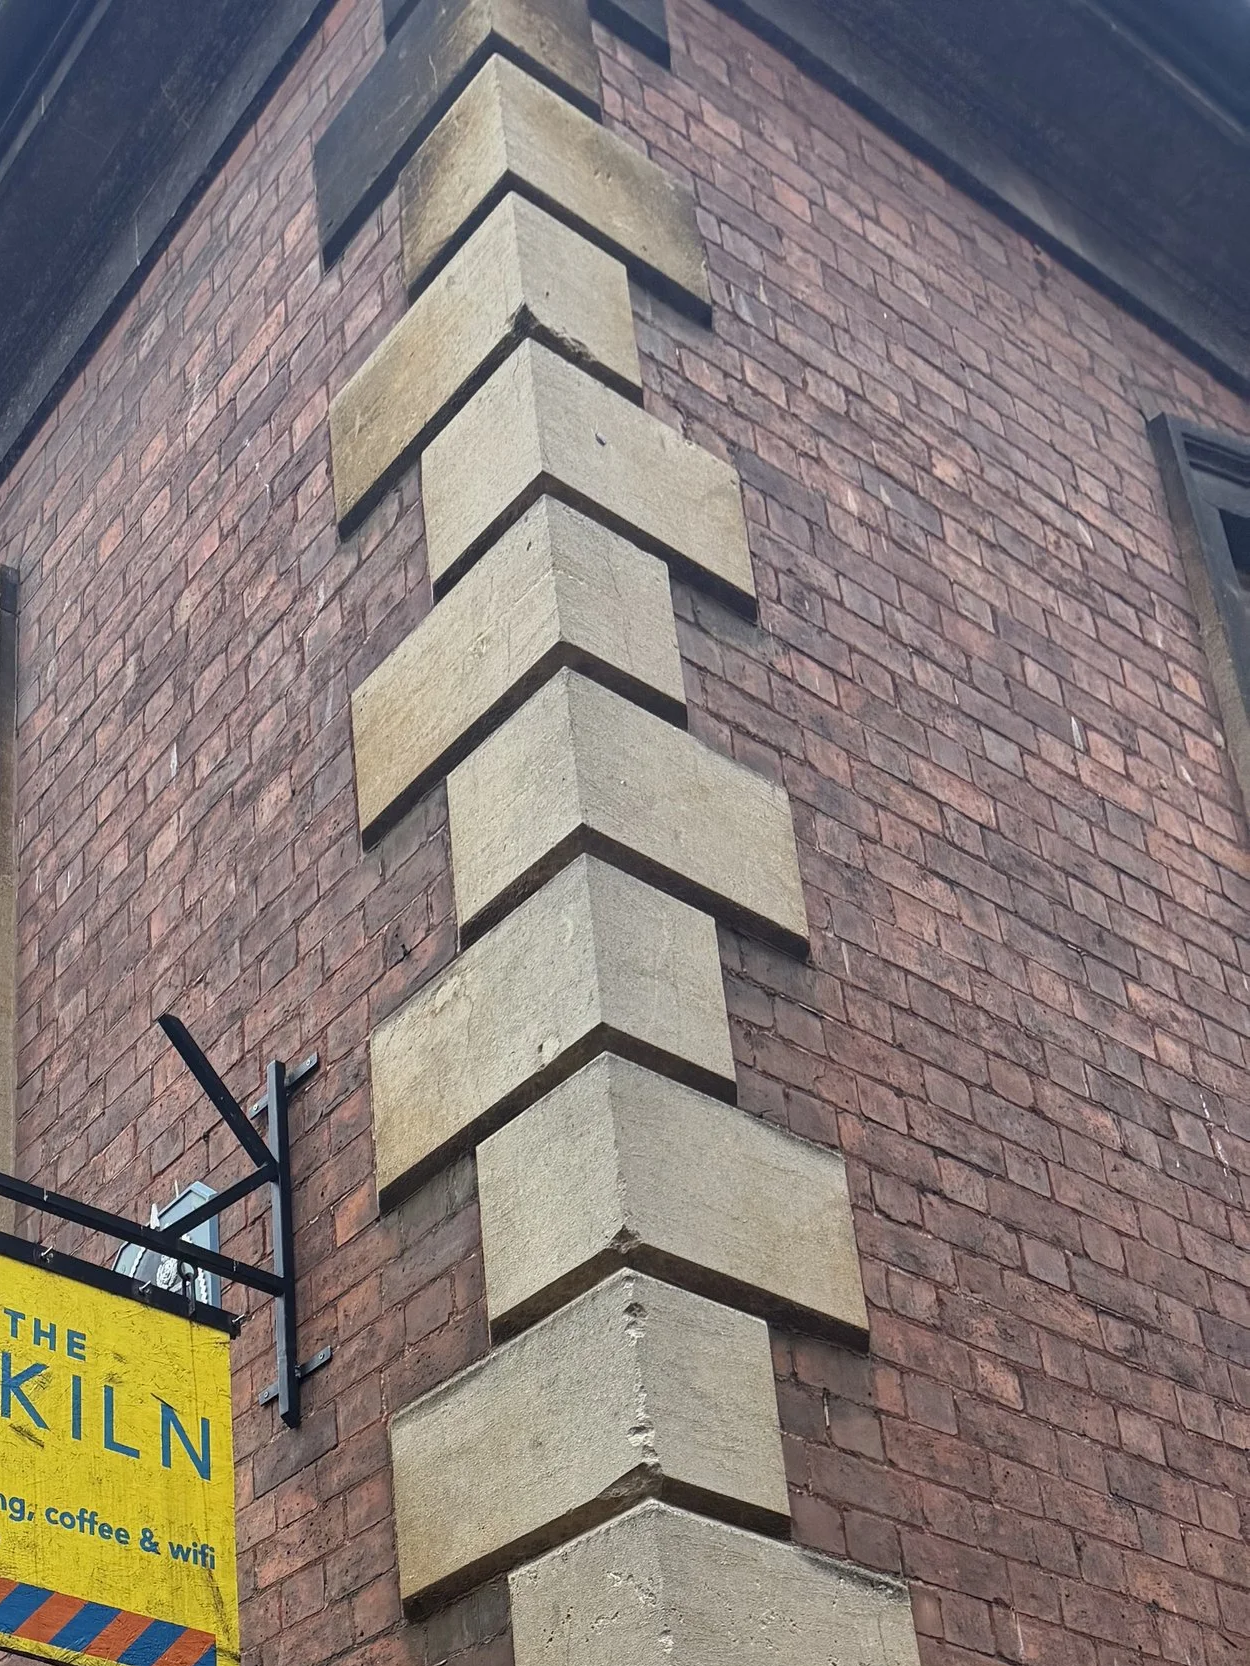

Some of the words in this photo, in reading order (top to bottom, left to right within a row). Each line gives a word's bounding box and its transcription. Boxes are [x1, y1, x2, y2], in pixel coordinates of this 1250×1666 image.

[3, 1308, 87, 1361] THE
[0, 1351, 211, 1481] KILN
[45, 1507, 130, 1545] coffee
[139, 1528, 159, 1554] &
[169, 1542, 216, 1570] wifi
